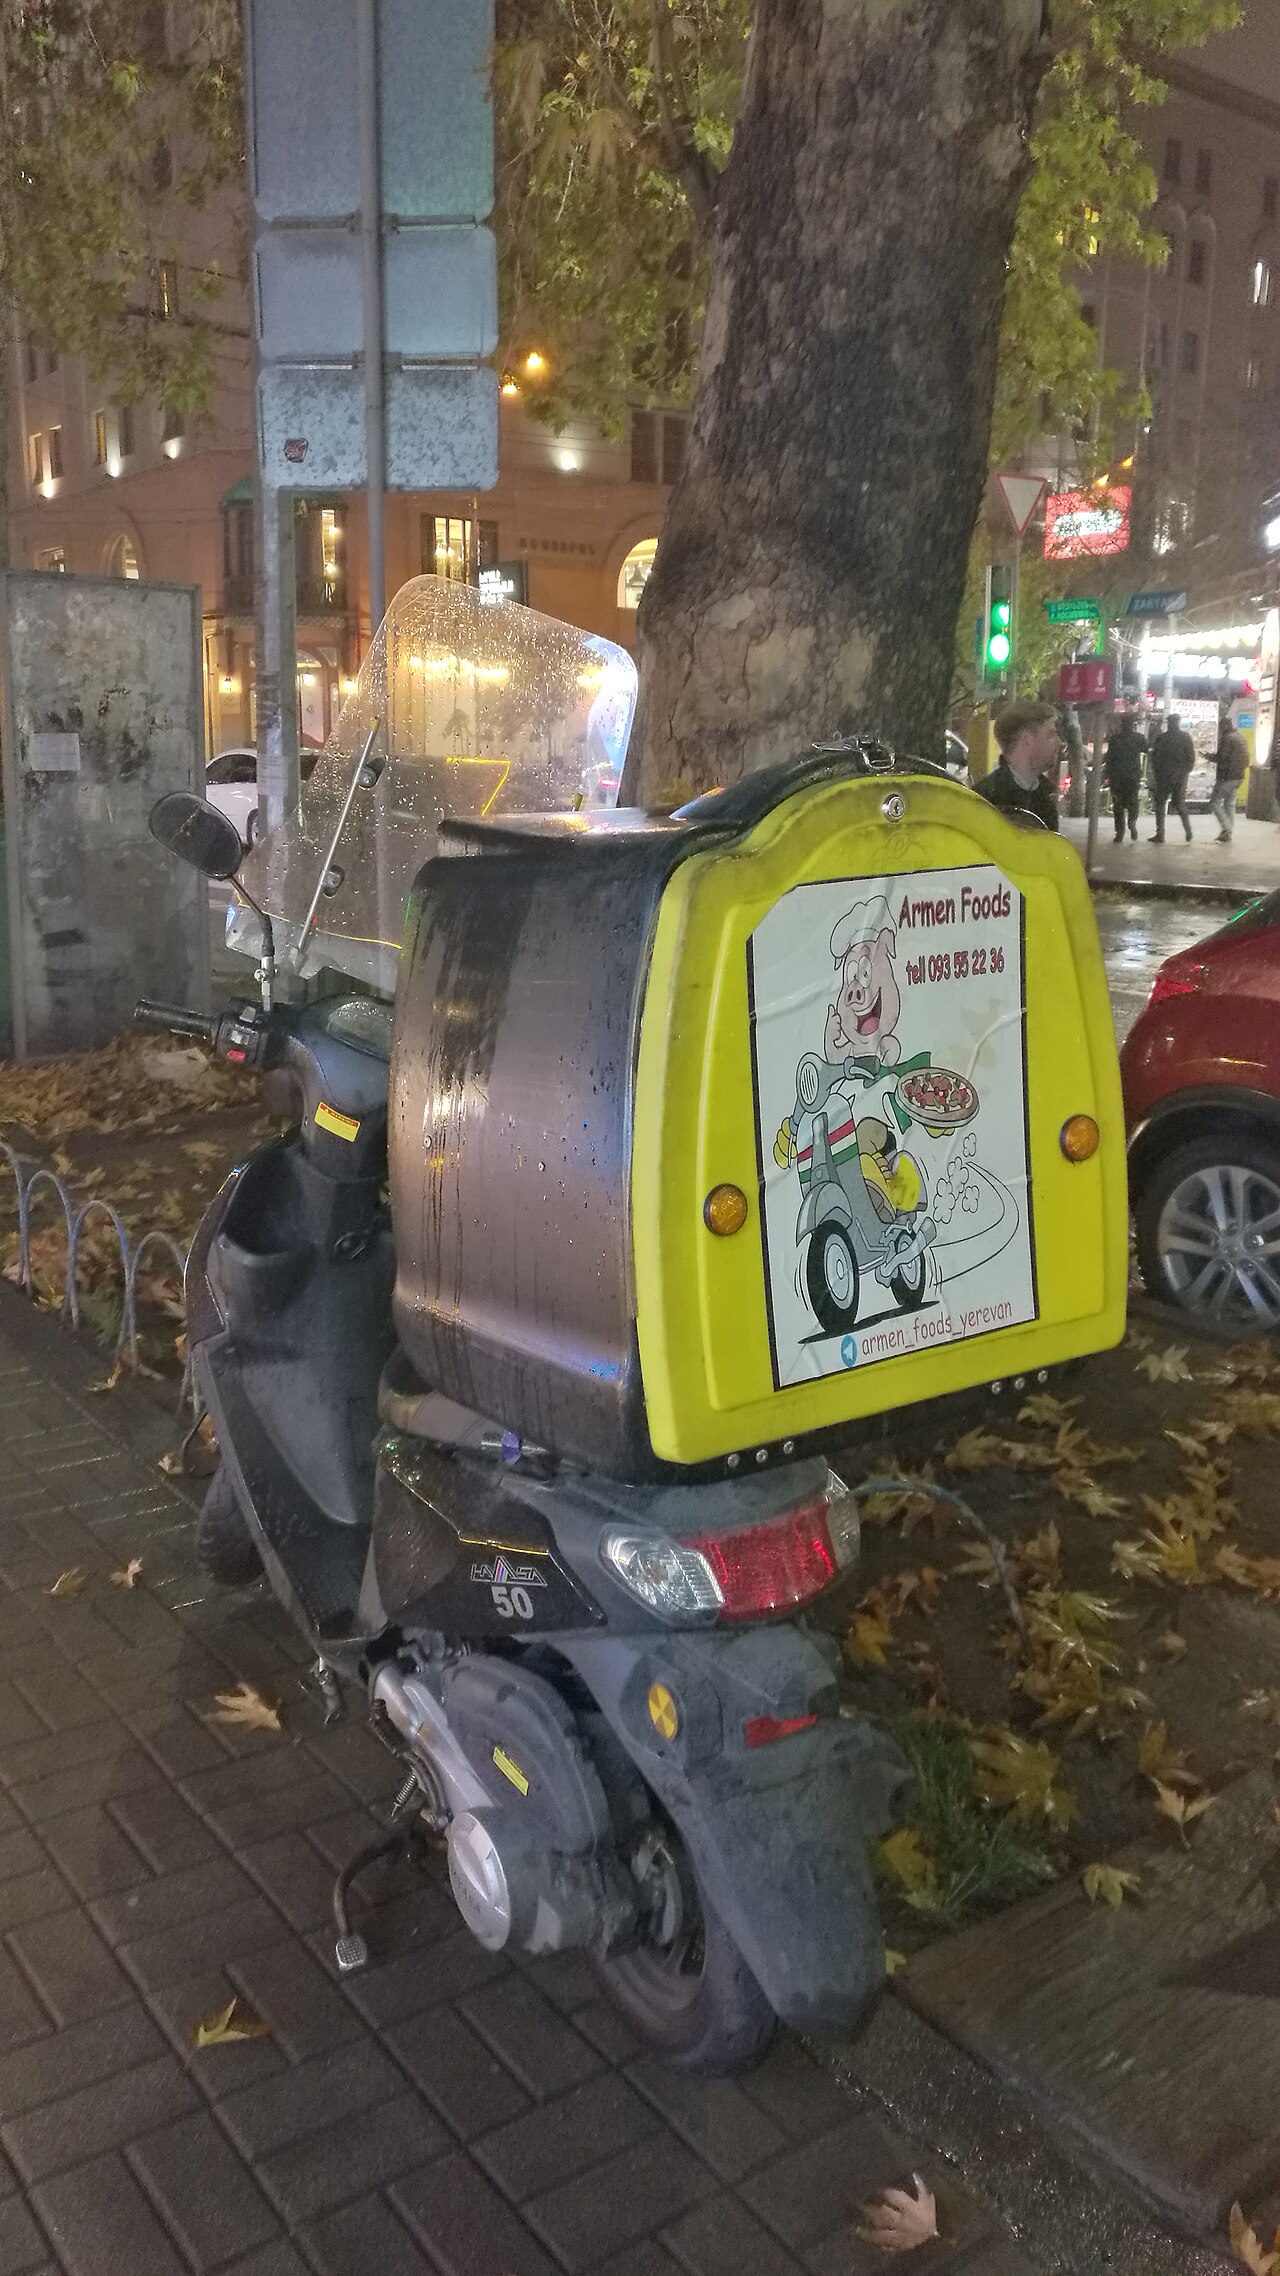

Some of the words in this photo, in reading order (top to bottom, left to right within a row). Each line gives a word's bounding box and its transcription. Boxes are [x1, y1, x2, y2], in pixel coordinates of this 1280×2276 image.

[898, 895, 956, 930] Armen
[960, 883, 1012, 923] Foods
[905, 955, 926, 986] tell
[927, 953, 951, 982] 093
[953, 950, 969, 979] 55
[971, 948, 987, 976] 22
[989, 946, 1005, 974] 36
[861, 1300, 1013, 1356] armen_foods_yerevan
[491, 1586, 535, 1619] 50
